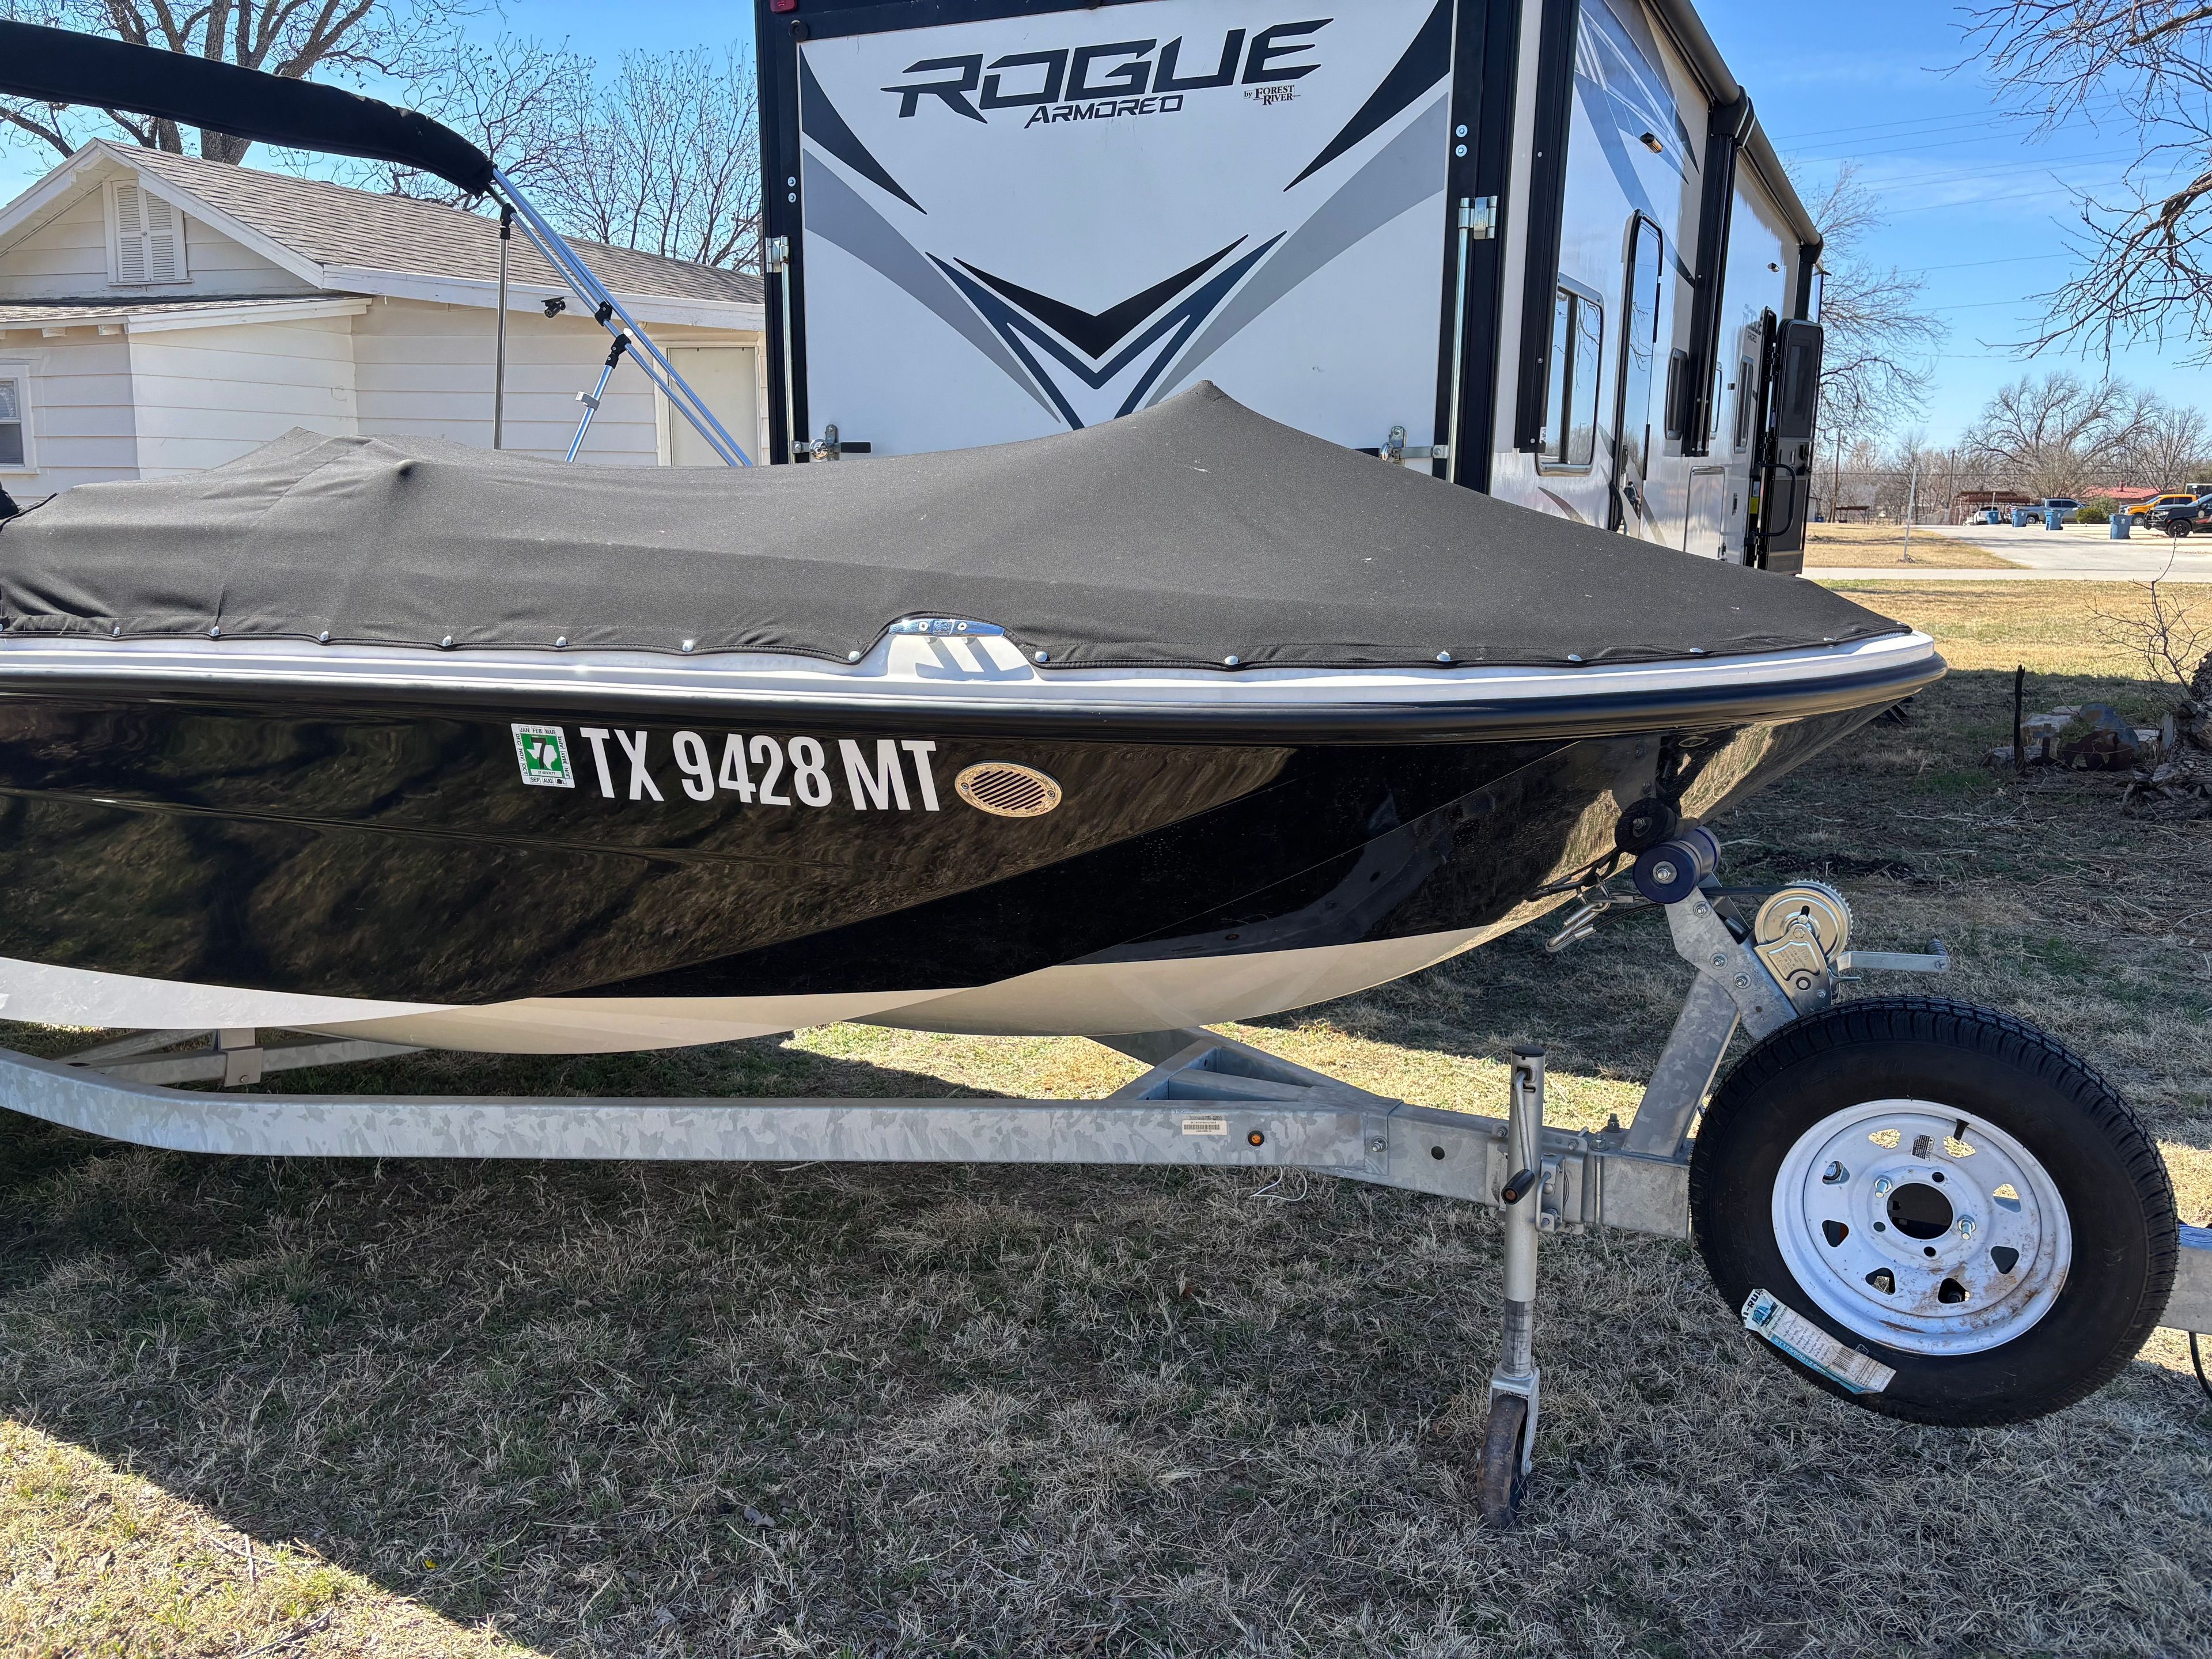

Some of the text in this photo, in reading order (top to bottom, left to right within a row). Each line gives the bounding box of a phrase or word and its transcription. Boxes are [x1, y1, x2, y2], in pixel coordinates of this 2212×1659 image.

[880, 17, 1334, 123] ROGUE
[1255, 85, 1294, 99] FOREST
[1263, 93, 1294, 105] RIVER
[1024, 94, 1184, 129] ARMORED
[530, 737, 546, 770] 7
[579, 727, 940, 811] TX 9428 MT
